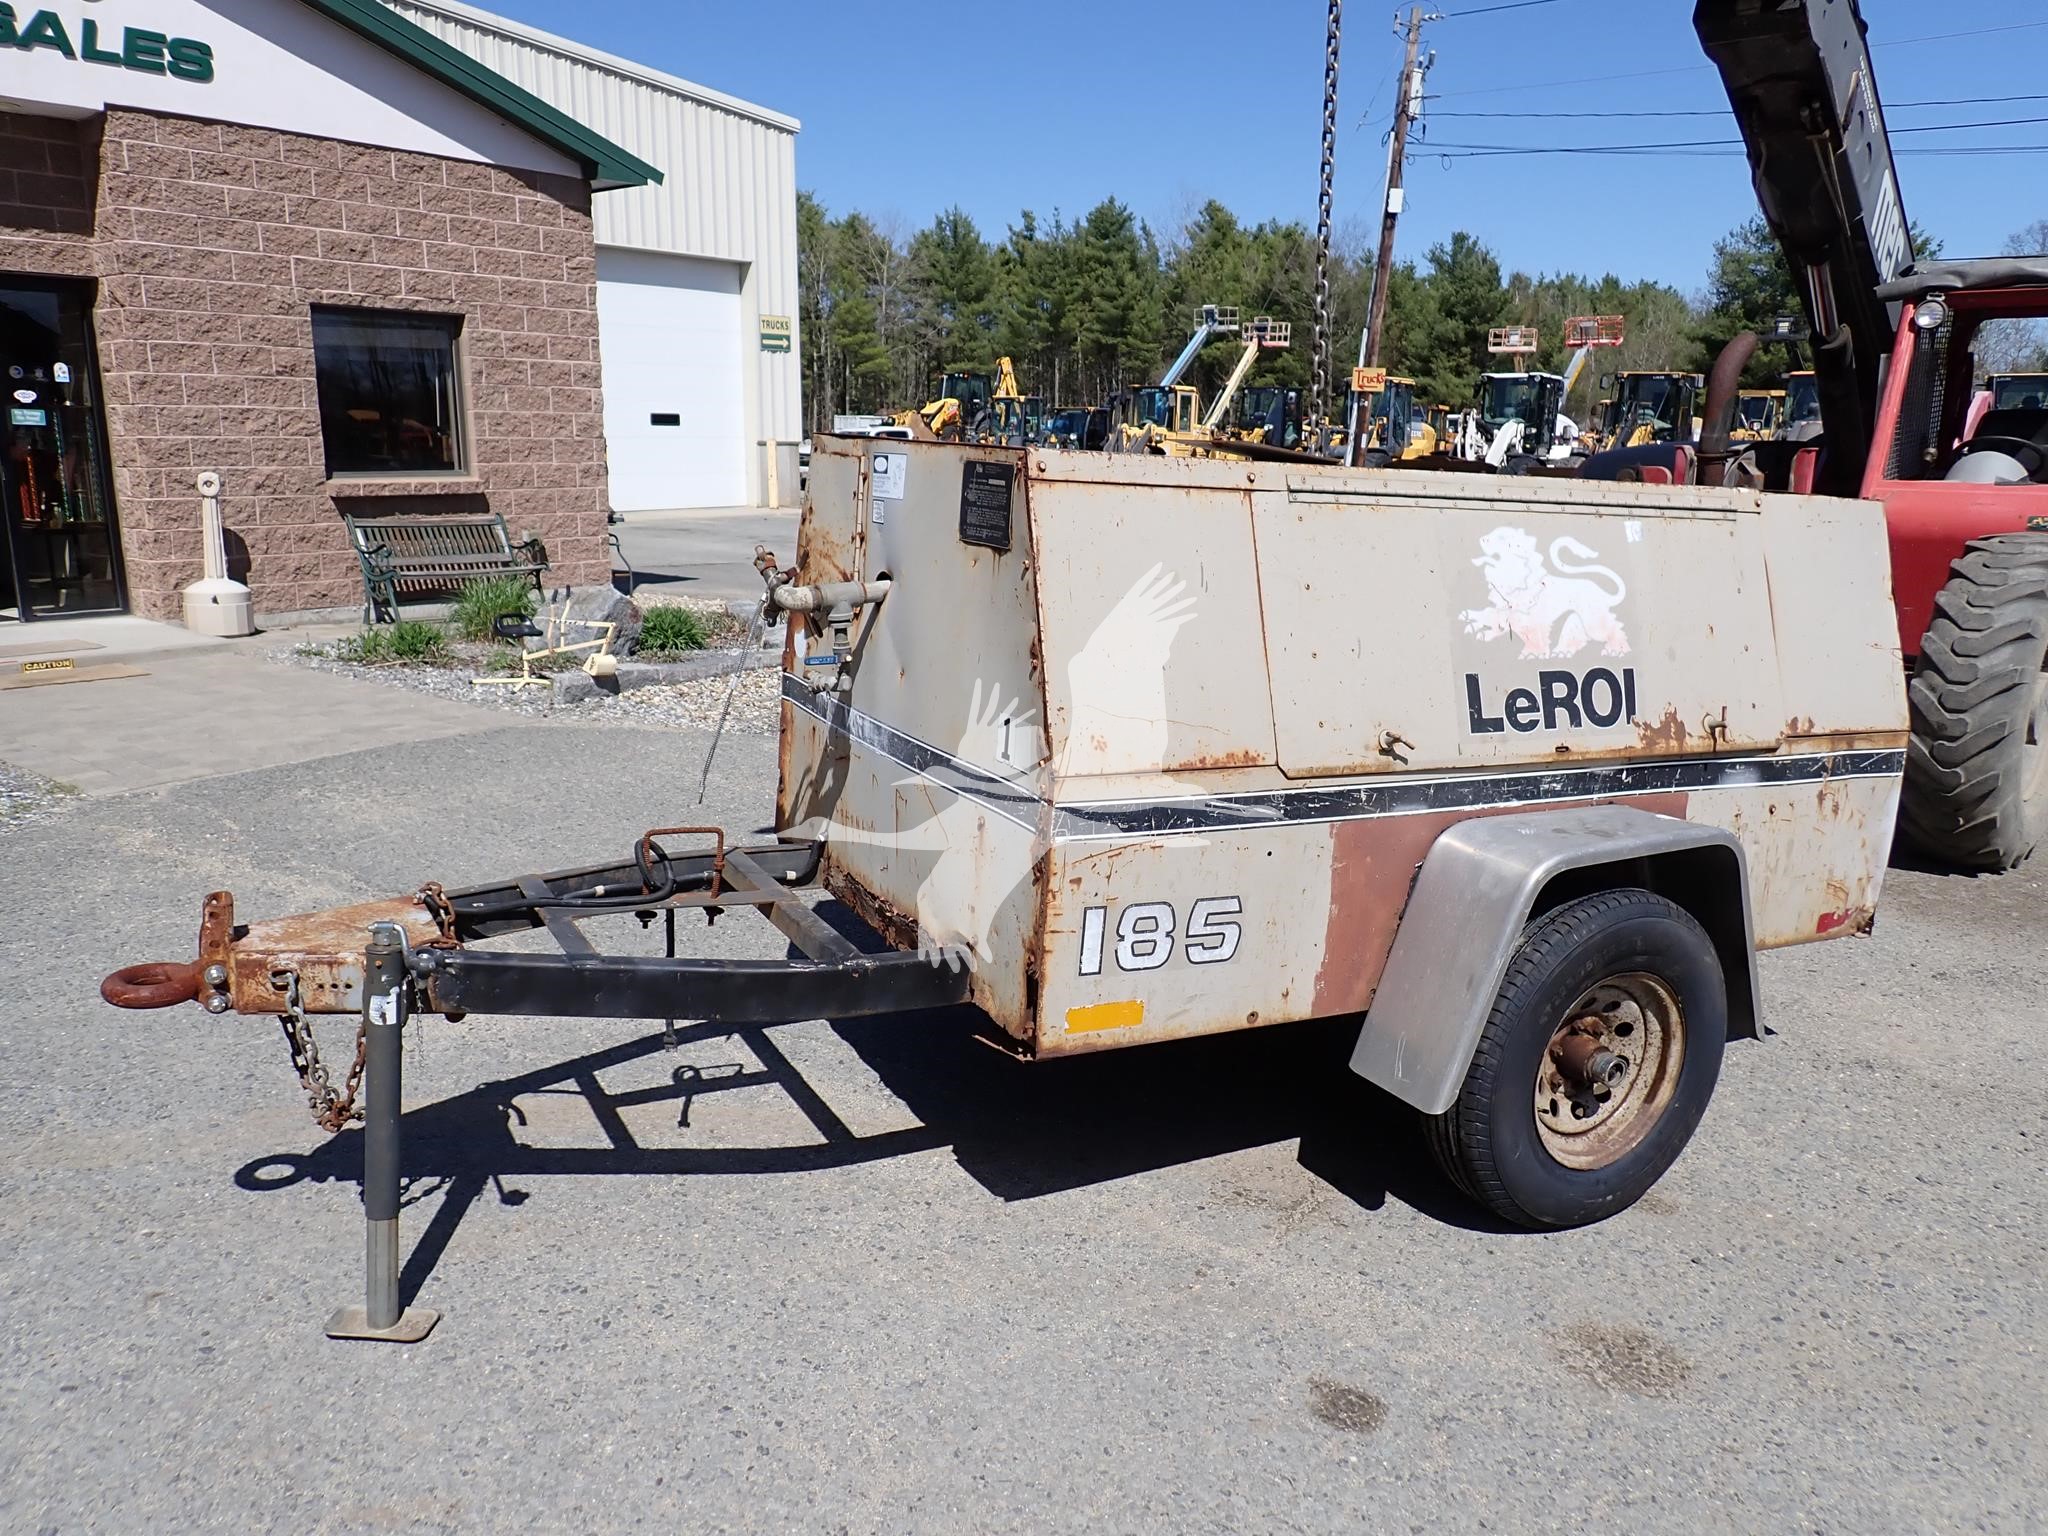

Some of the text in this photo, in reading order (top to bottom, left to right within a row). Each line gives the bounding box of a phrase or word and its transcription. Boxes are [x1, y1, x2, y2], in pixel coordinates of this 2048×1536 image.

[761, 319, 789, 330] TRUCKS
[1355, 369, 1386, 385] Trucks
[25, 660, 70, 671] CAUTION
[1465, 667, 1636, 734] LeROI
[1078, 895, 1242, 976] 185
